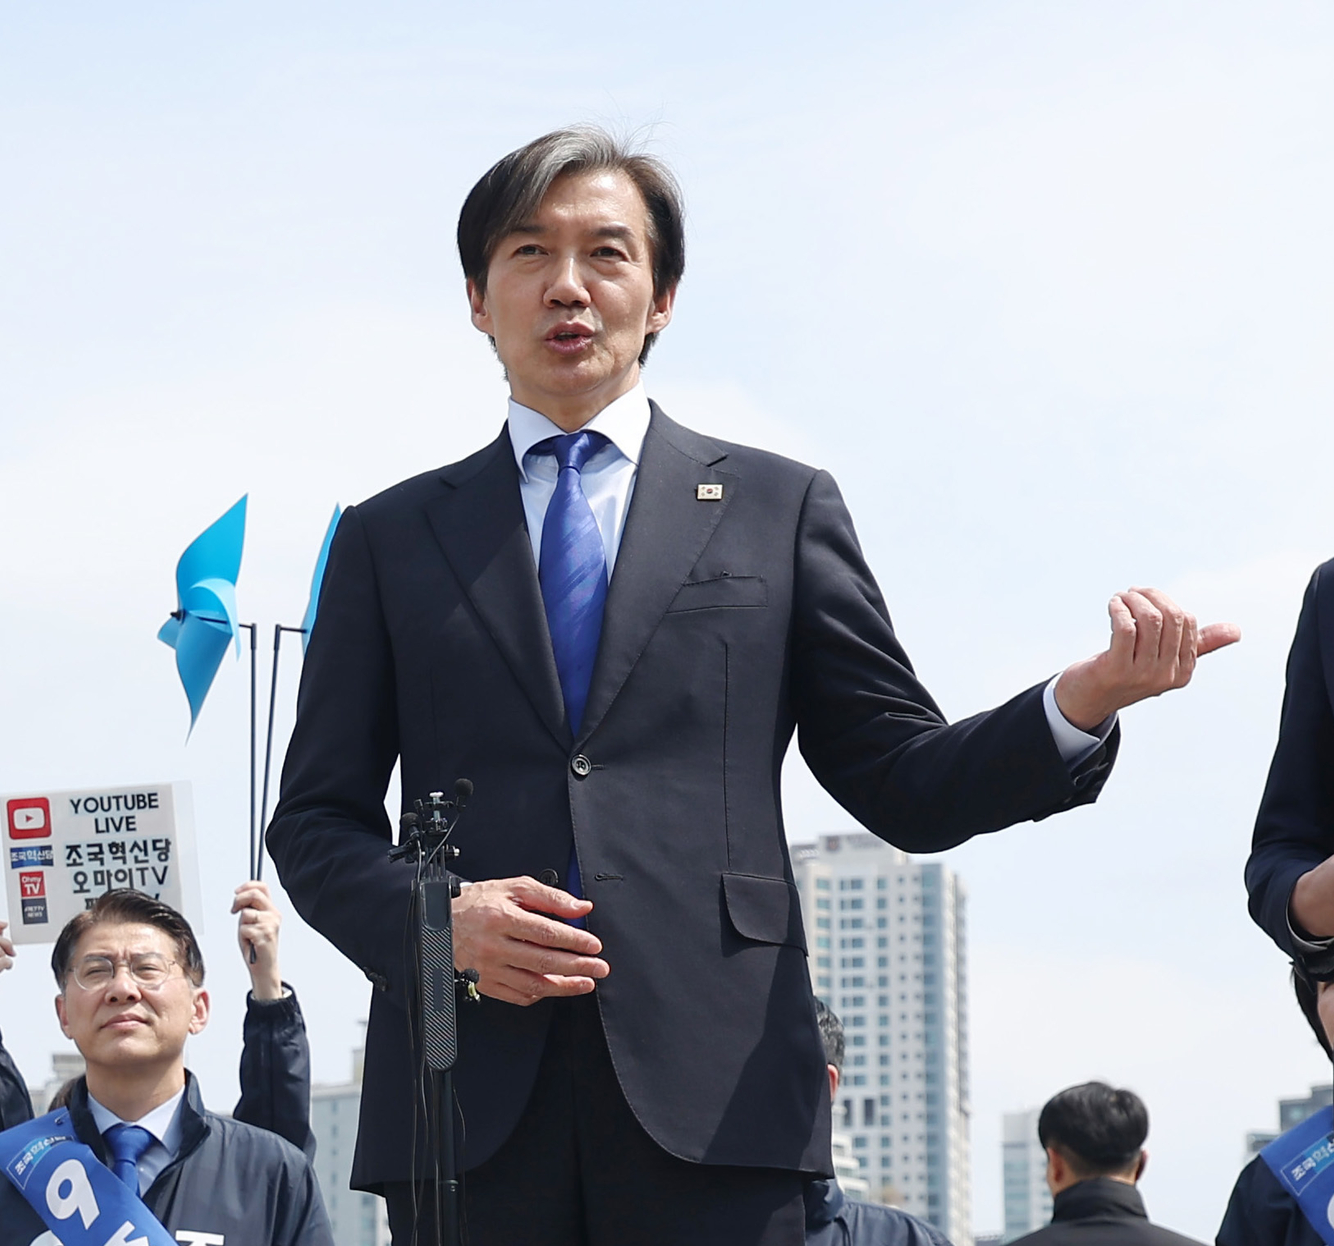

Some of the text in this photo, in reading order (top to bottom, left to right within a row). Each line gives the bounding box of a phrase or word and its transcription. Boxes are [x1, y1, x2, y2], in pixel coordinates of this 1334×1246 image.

[69, 792, 160, 814] YOUTUBE
[94, 815, 138, 834] LIVE
[65, 838, 172, 867] 조국혁신당
[24, 883, 41, 895] TV
[46, 1158, 100, 1230] 9
